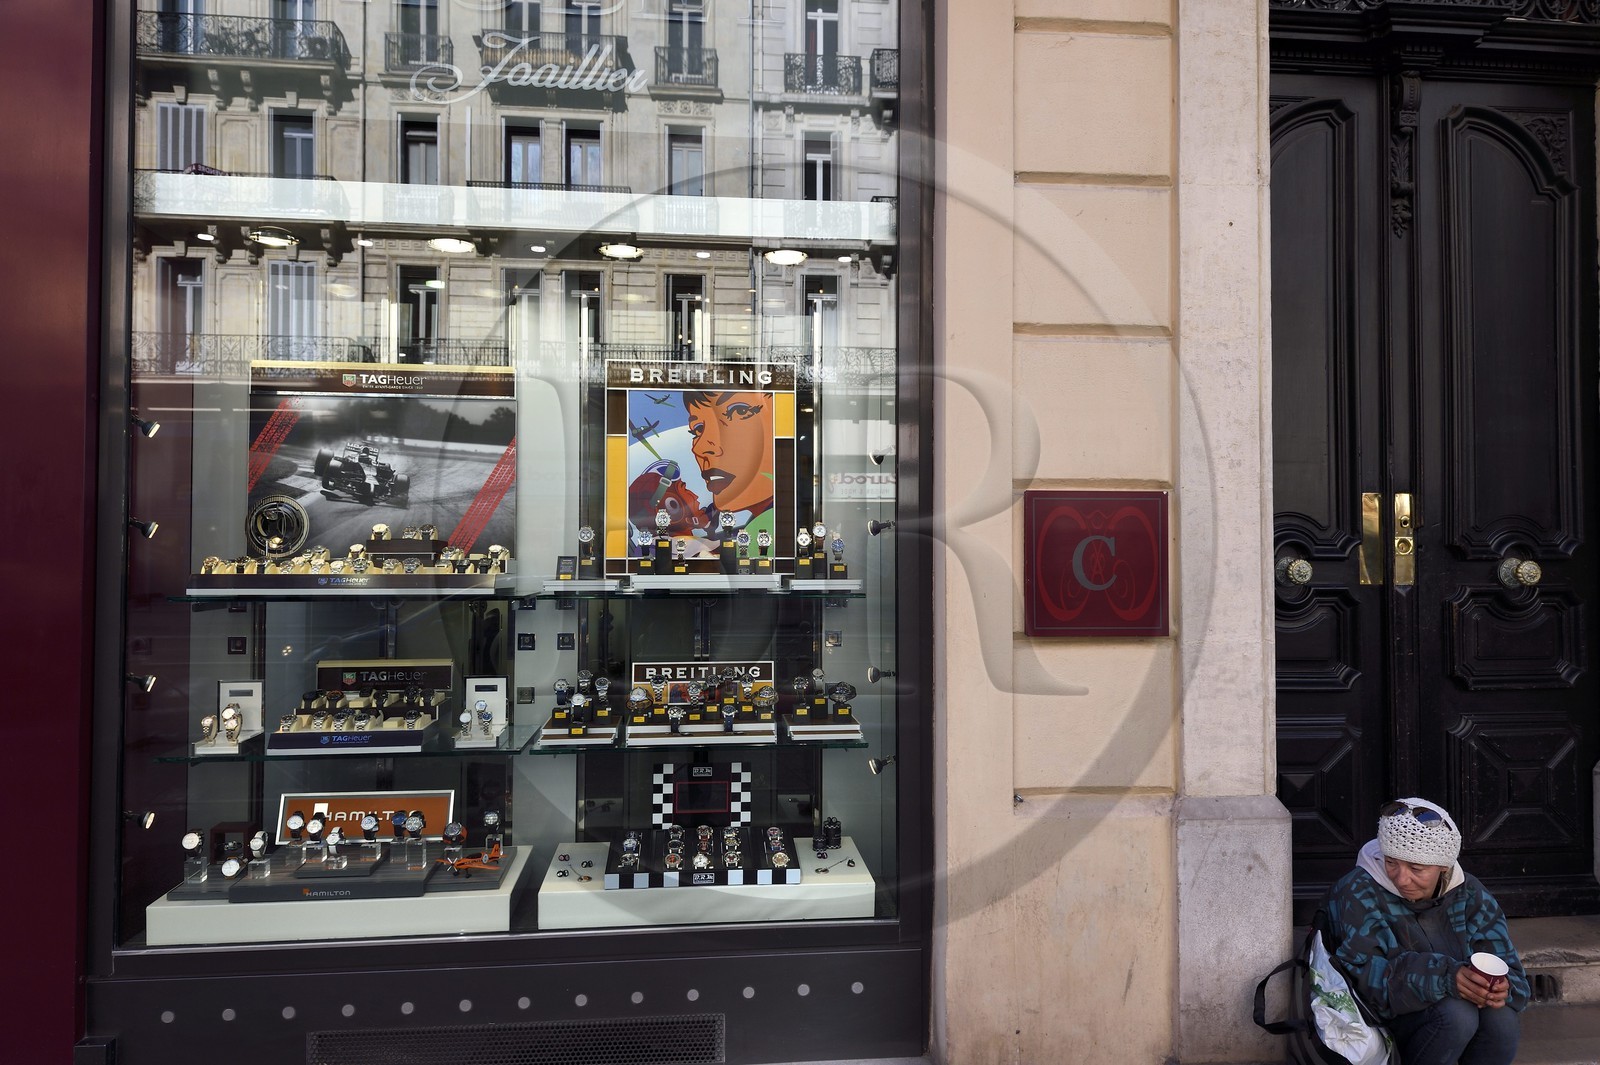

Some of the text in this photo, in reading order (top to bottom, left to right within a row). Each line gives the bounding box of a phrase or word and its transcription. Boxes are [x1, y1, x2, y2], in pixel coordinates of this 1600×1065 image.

[409, 31, 649, 105] Joaillier
[630, 367, 773, 386] BREITLING
[1072, 535, 1118, 591] C
[645, 666, 761, 680] BREITLNG
